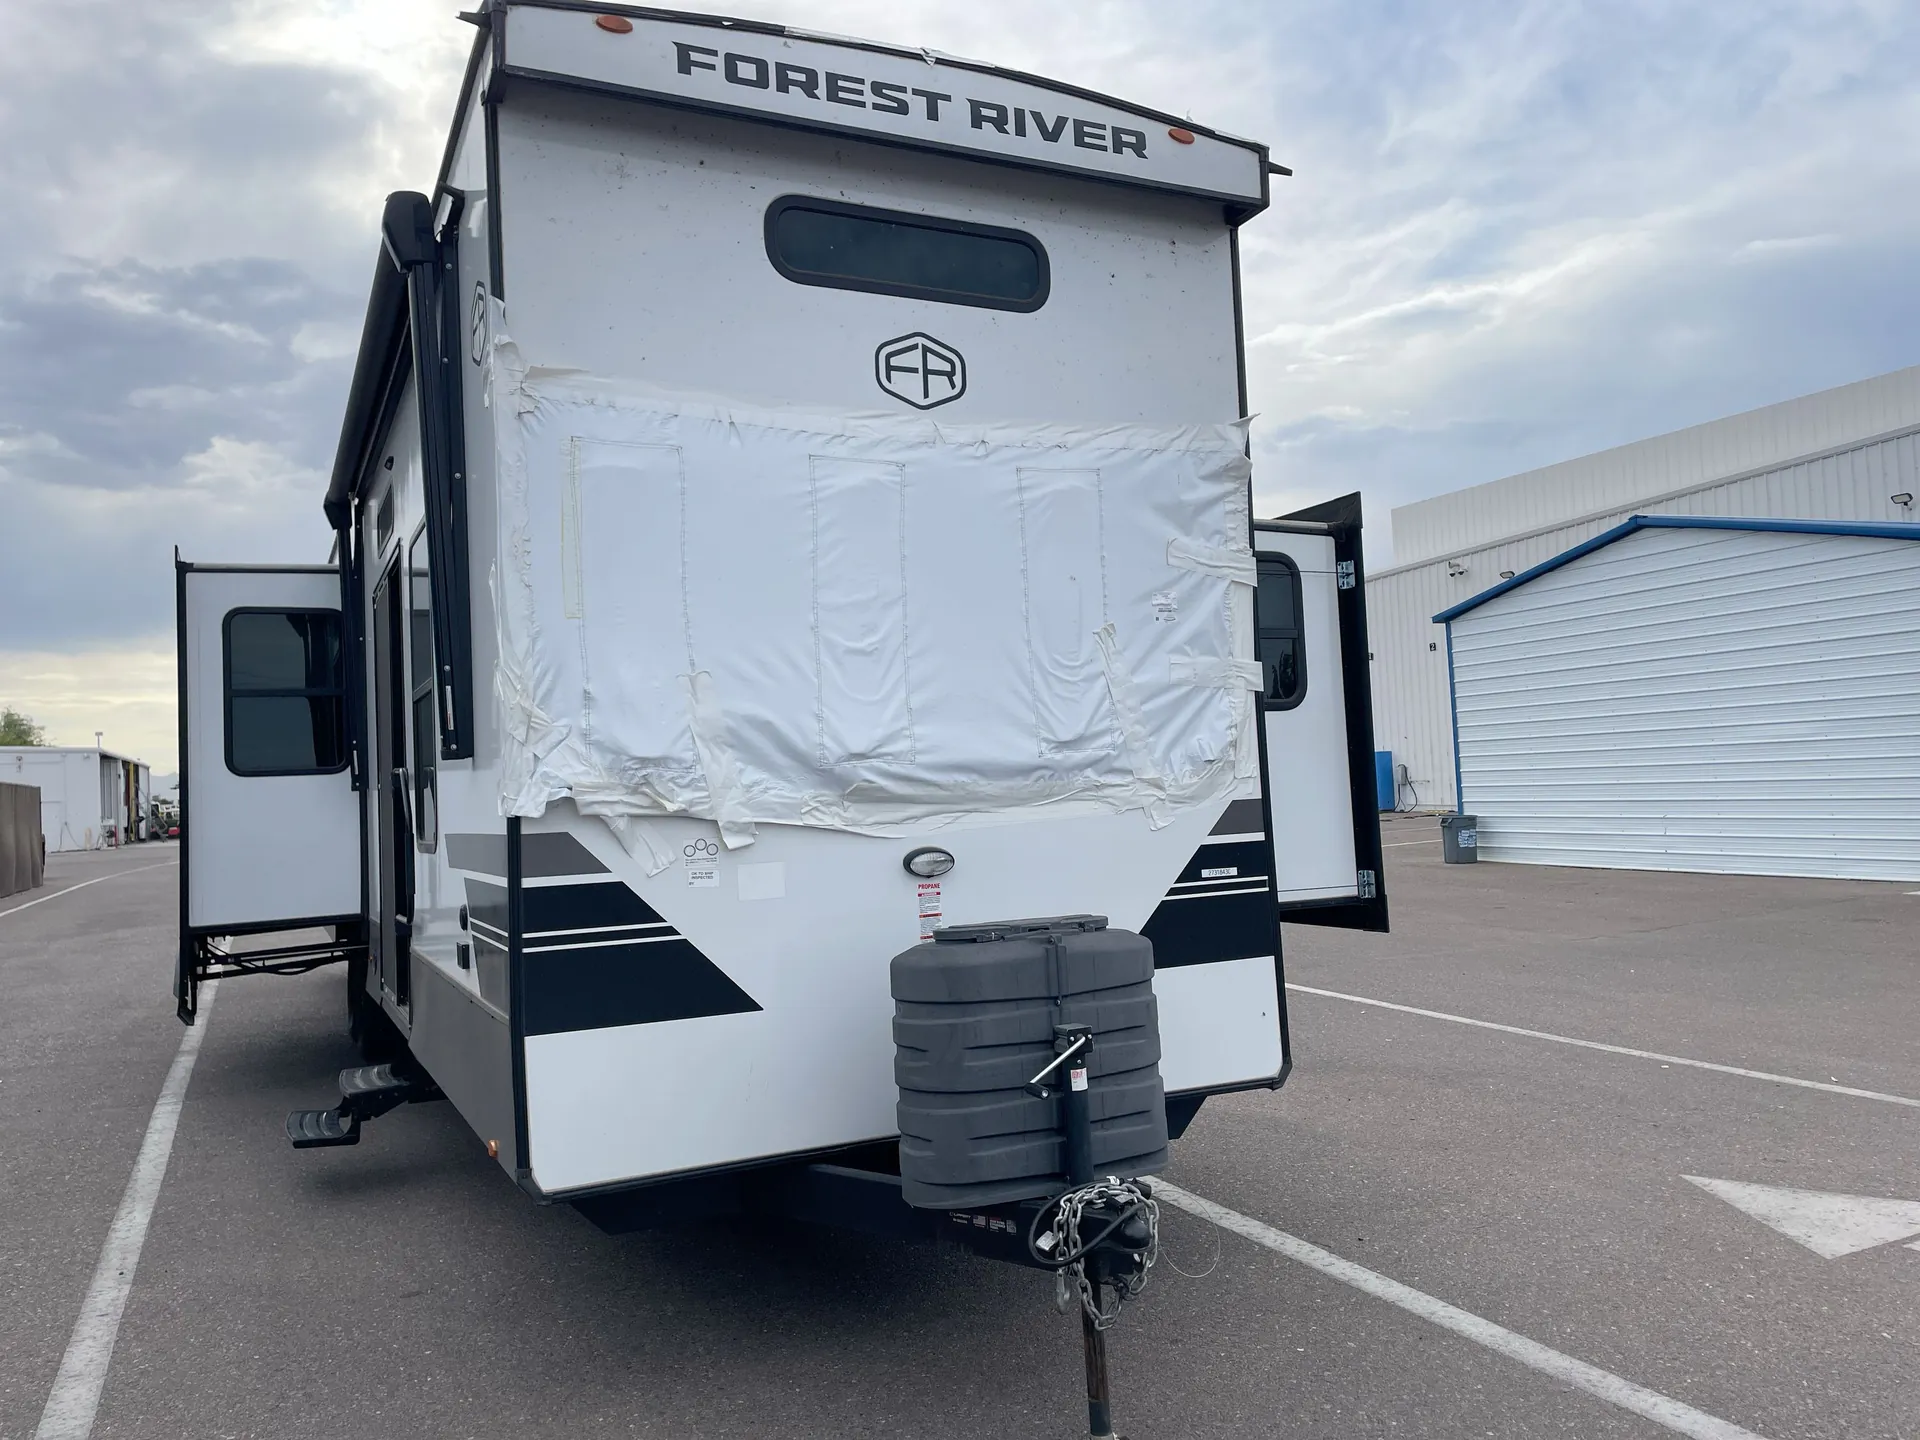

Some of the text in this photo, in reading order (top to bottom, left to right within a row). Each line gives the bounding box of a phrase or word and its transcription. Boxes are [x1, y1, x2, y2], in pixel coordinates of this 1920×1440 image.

[672, 41, 1149, 159] FOREST RIVER
[884, 342, 957, 400] FR
